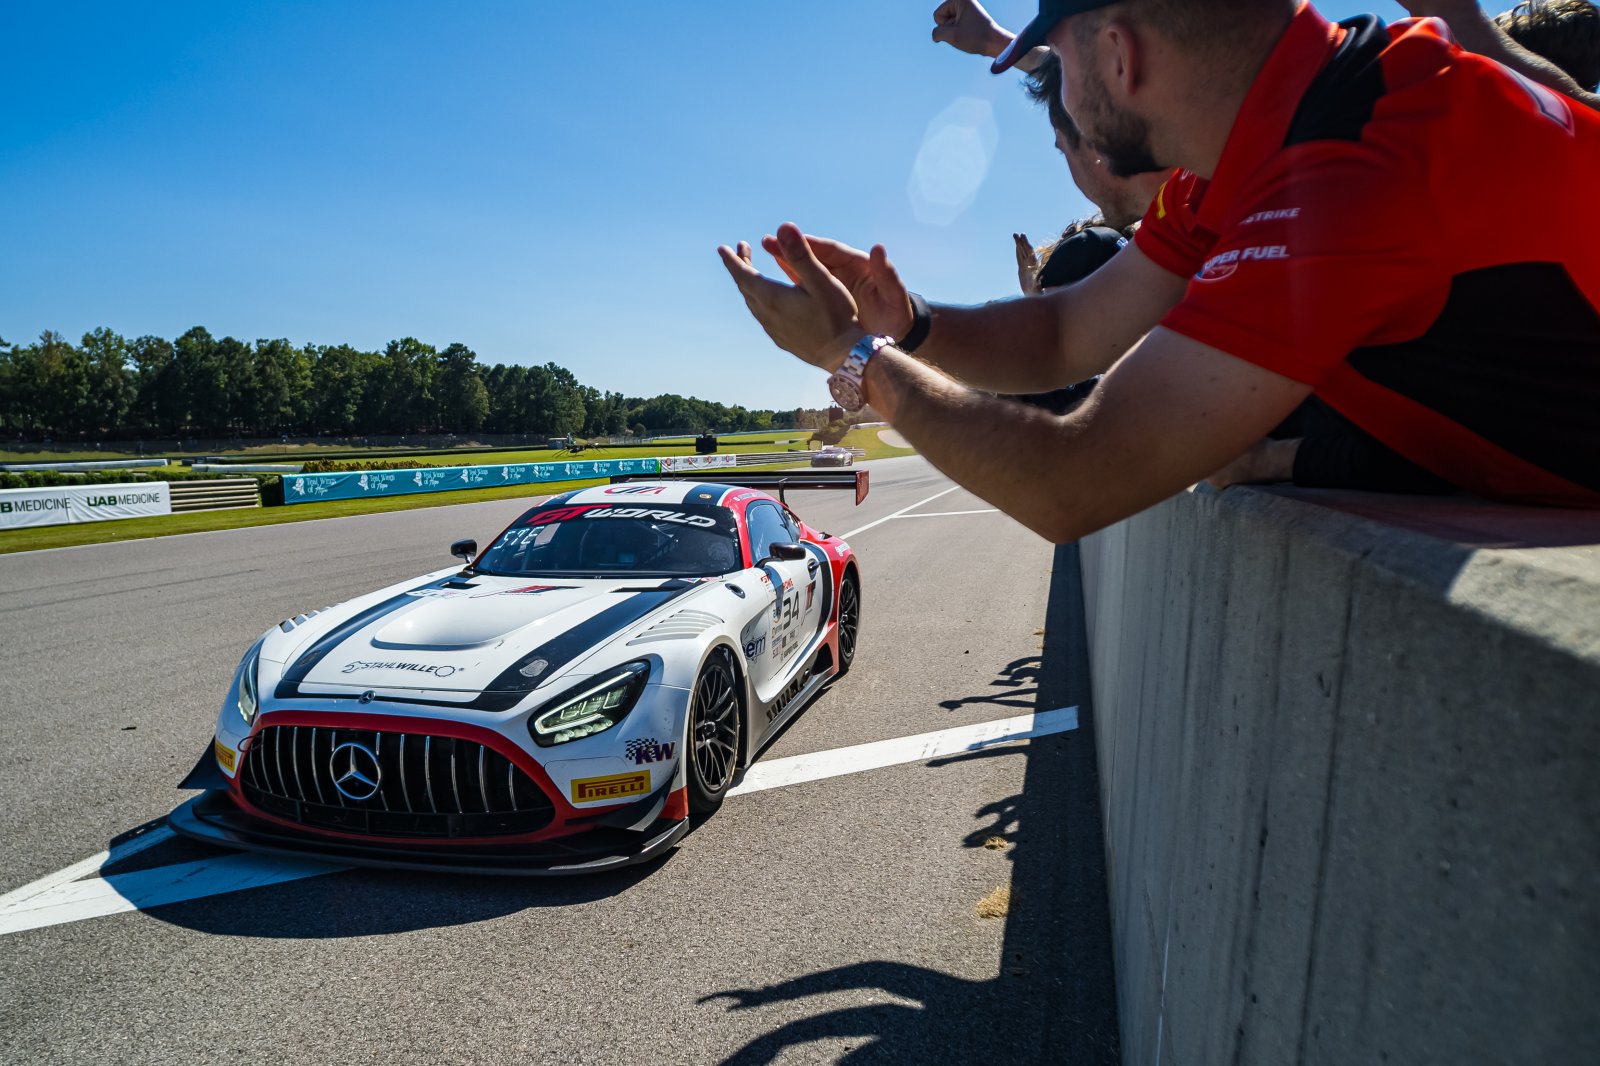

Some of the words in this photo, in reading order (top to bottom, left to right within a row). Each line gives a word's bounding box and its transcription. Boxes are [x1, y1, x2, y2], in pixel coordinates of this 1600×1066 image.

[1241, 245, 1290, 260] FUEL
[0, 501, 13, 513] B
[14, 497, 71, 512] MEDICINE
[86, 495, 118, 507] UAB
[118, 492, 161, 505] MEDICINE
[527, 503, 613, 526] GT
[583, 508, 717, 528] WORLD
[783, 590, 799, 631] 34
[360, 661, 437, 673] STAHLWILLE
[635, 741, 676, 765] KW
[577, 775, 645, 799] PIRELLI
